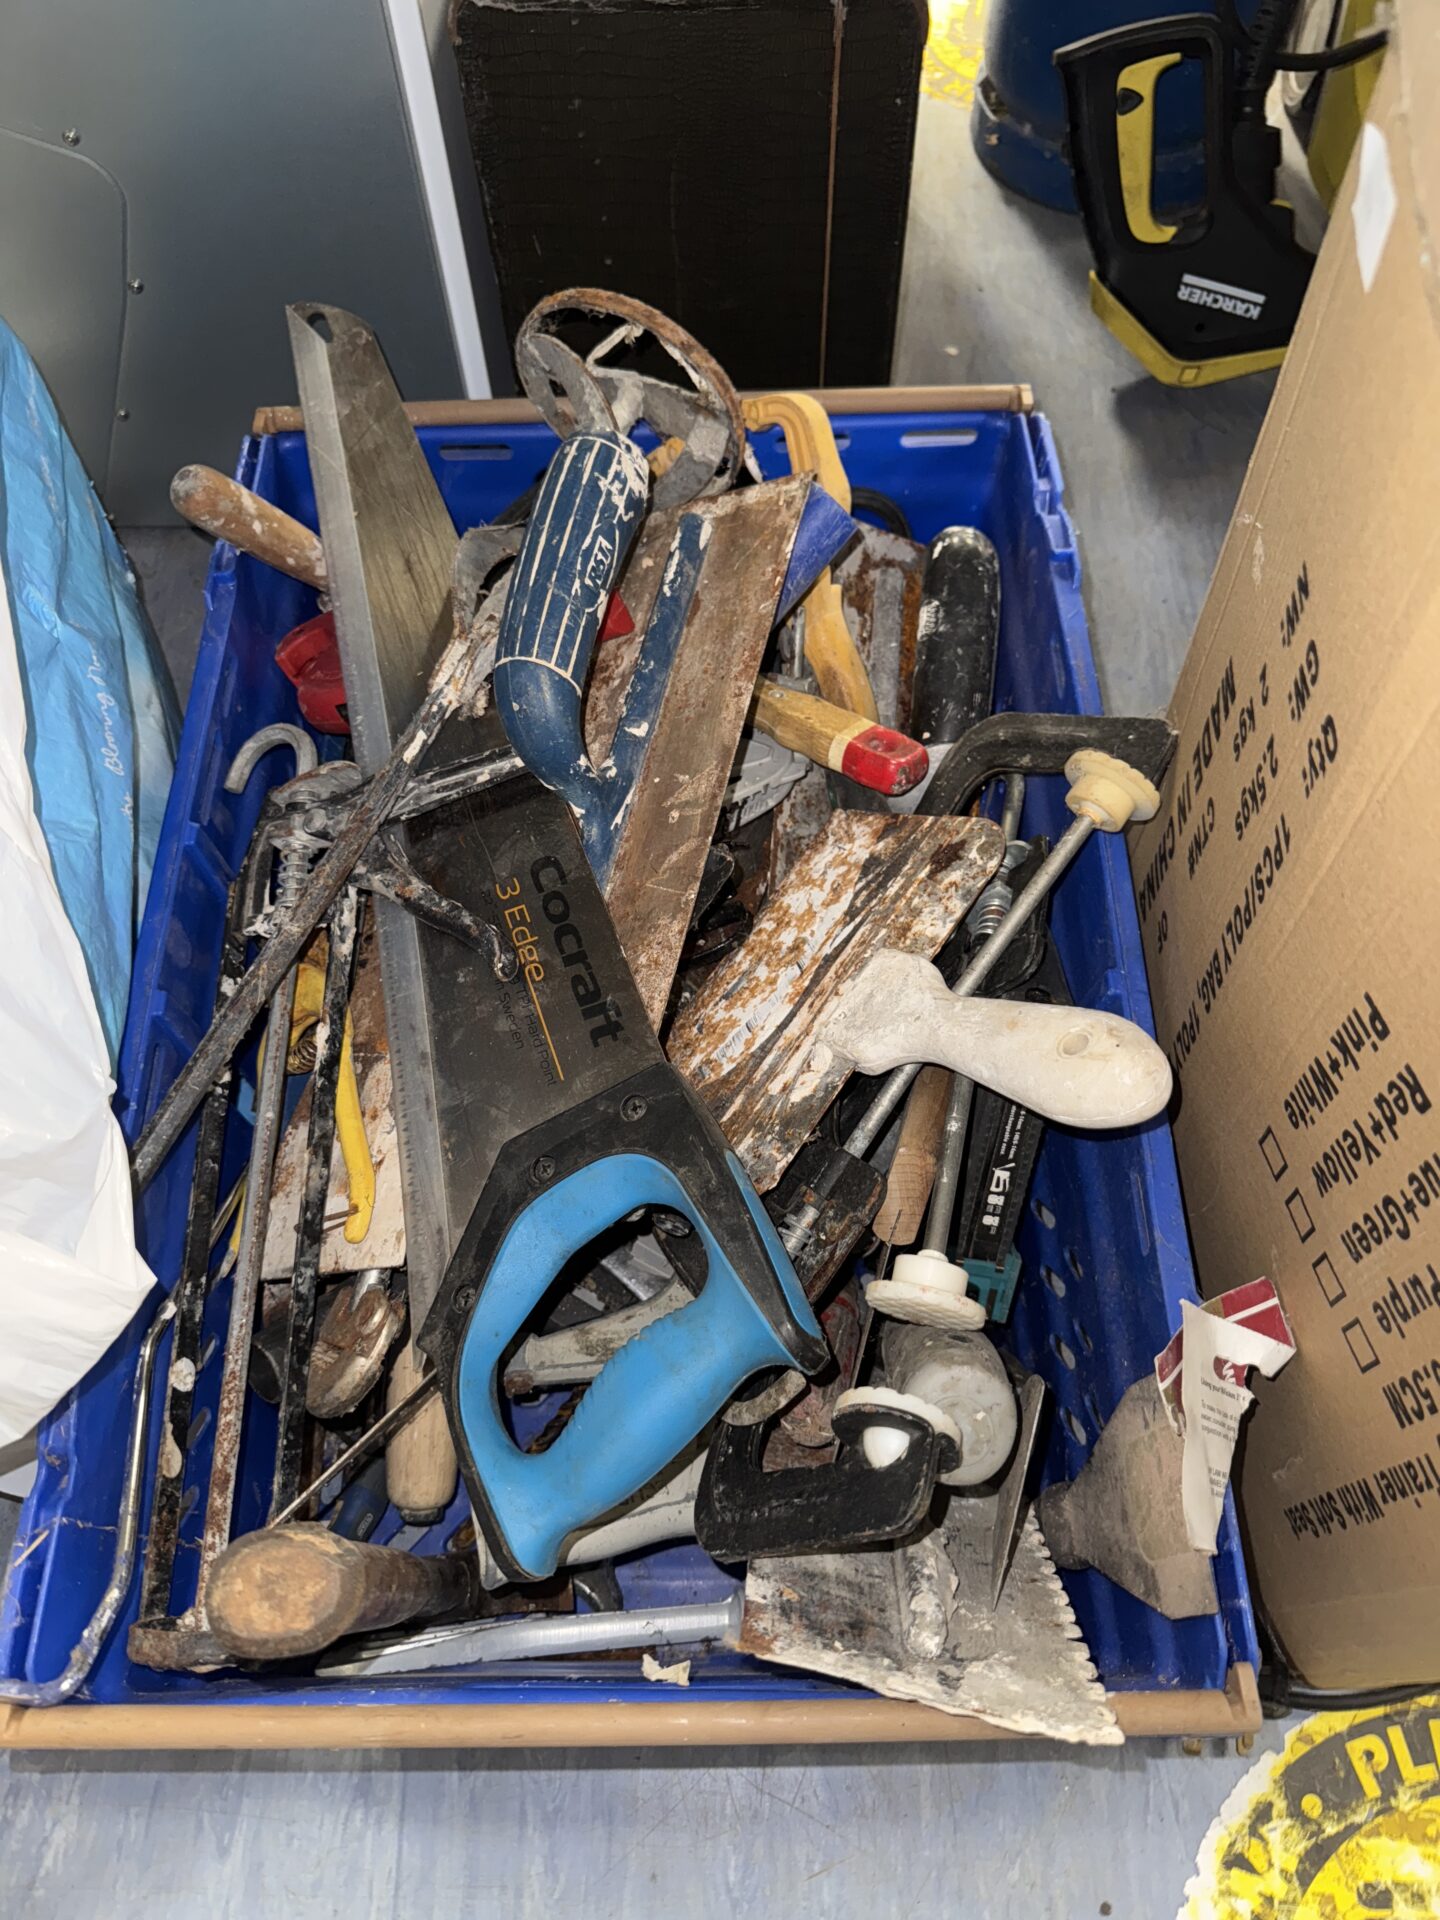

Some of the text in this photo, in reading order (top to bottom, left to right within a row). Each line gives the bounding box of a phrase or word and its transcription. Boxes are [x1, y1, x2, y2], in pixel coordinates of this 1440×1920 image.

[1280, 561, 1311, 648] NW:
[1258, 662, 1270, 707] 2
[1233, 696, 1255, 762] kgs
[1234, 638, 1320, 841] GW: 2.5kgs
[1301, 714, 1338, 799] Qty:
[1139, 656, 1236, 923] MADE IN CHINA
[1187, 797, 1215, 881] CTN#
[495, 877, 521, 900] 3
[1221, 813, 1291, 974] 1PCS/POLY
[504, 904, 545, 982] Edge
[530, 855, 625, 1048] Cocraft
[1197, 948, 1224, 1014] BAG,
[500, 992, 524, 1050] Sweden
[524, 1013, 546, 1048] Hard
[537, 1049, 557, 1087] Point
[1284, 991, 1390, 1130] Pink+White
[1311, 1063, 1432, 1198] Red+Yellow
[1283, 1453, 1440, 1541] Trainer With Soft Seat
